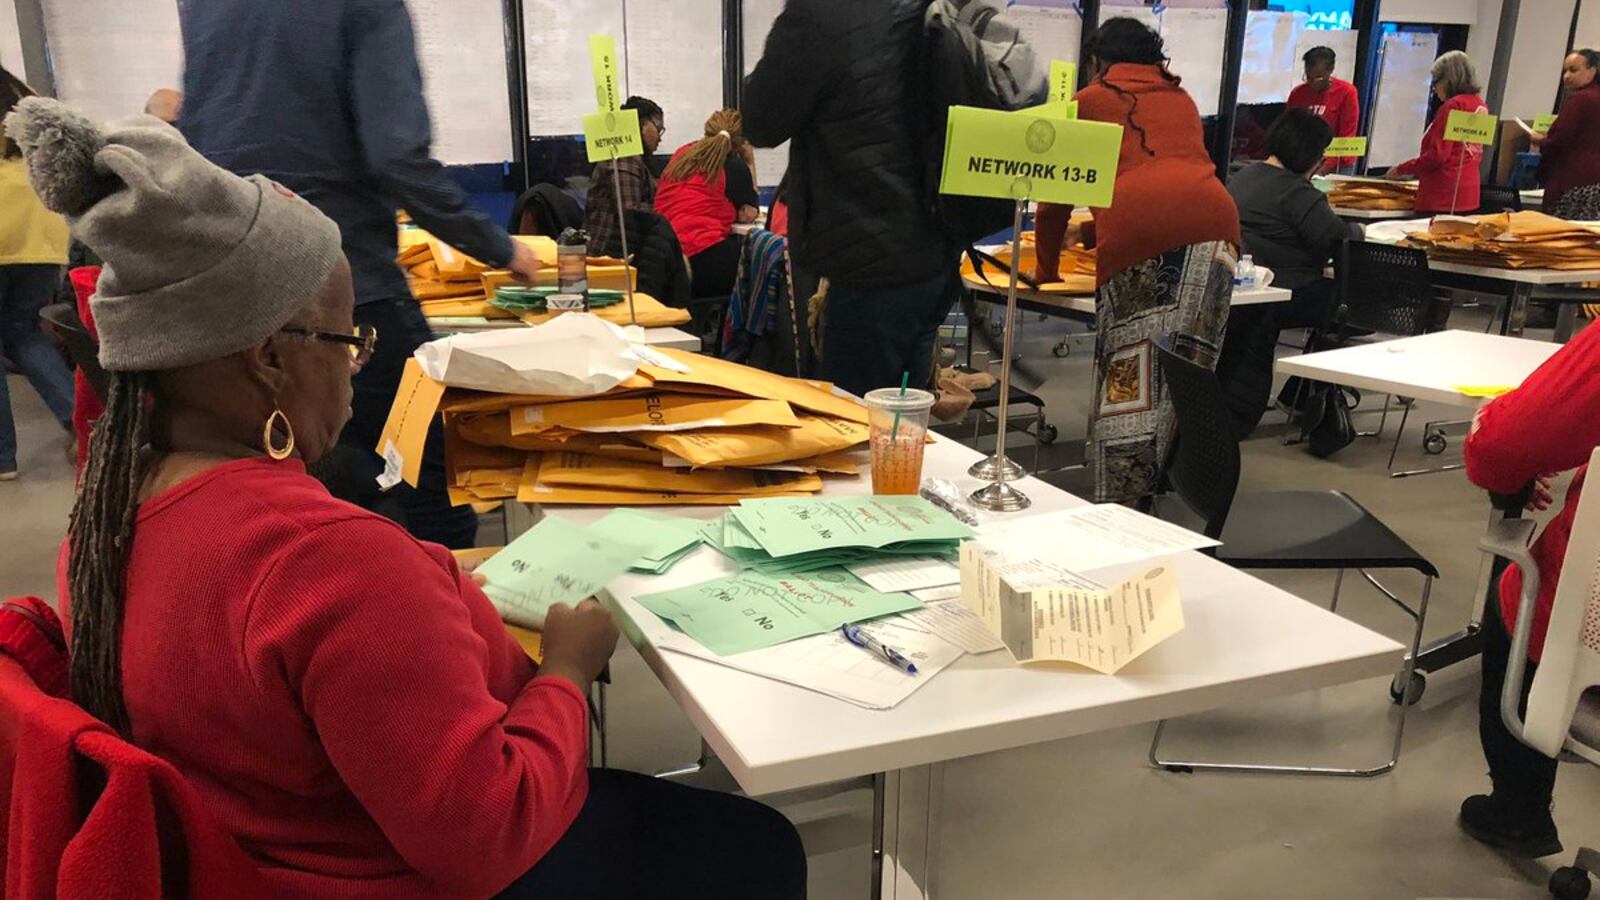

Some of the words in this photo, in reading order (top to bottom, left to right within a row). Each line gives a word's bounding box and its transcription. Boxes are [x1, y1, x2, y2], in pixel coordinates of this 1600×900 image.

[1453, 127, 1477, 136] NETWORK
[595, 137, 624, 148] NETWORK
[625, 134, 633, 144] 14
[968, 156, 1057, 180] NETWORK
[1062, 166, 1097, 184] 13-B
[753, 615, 775, 631] No
